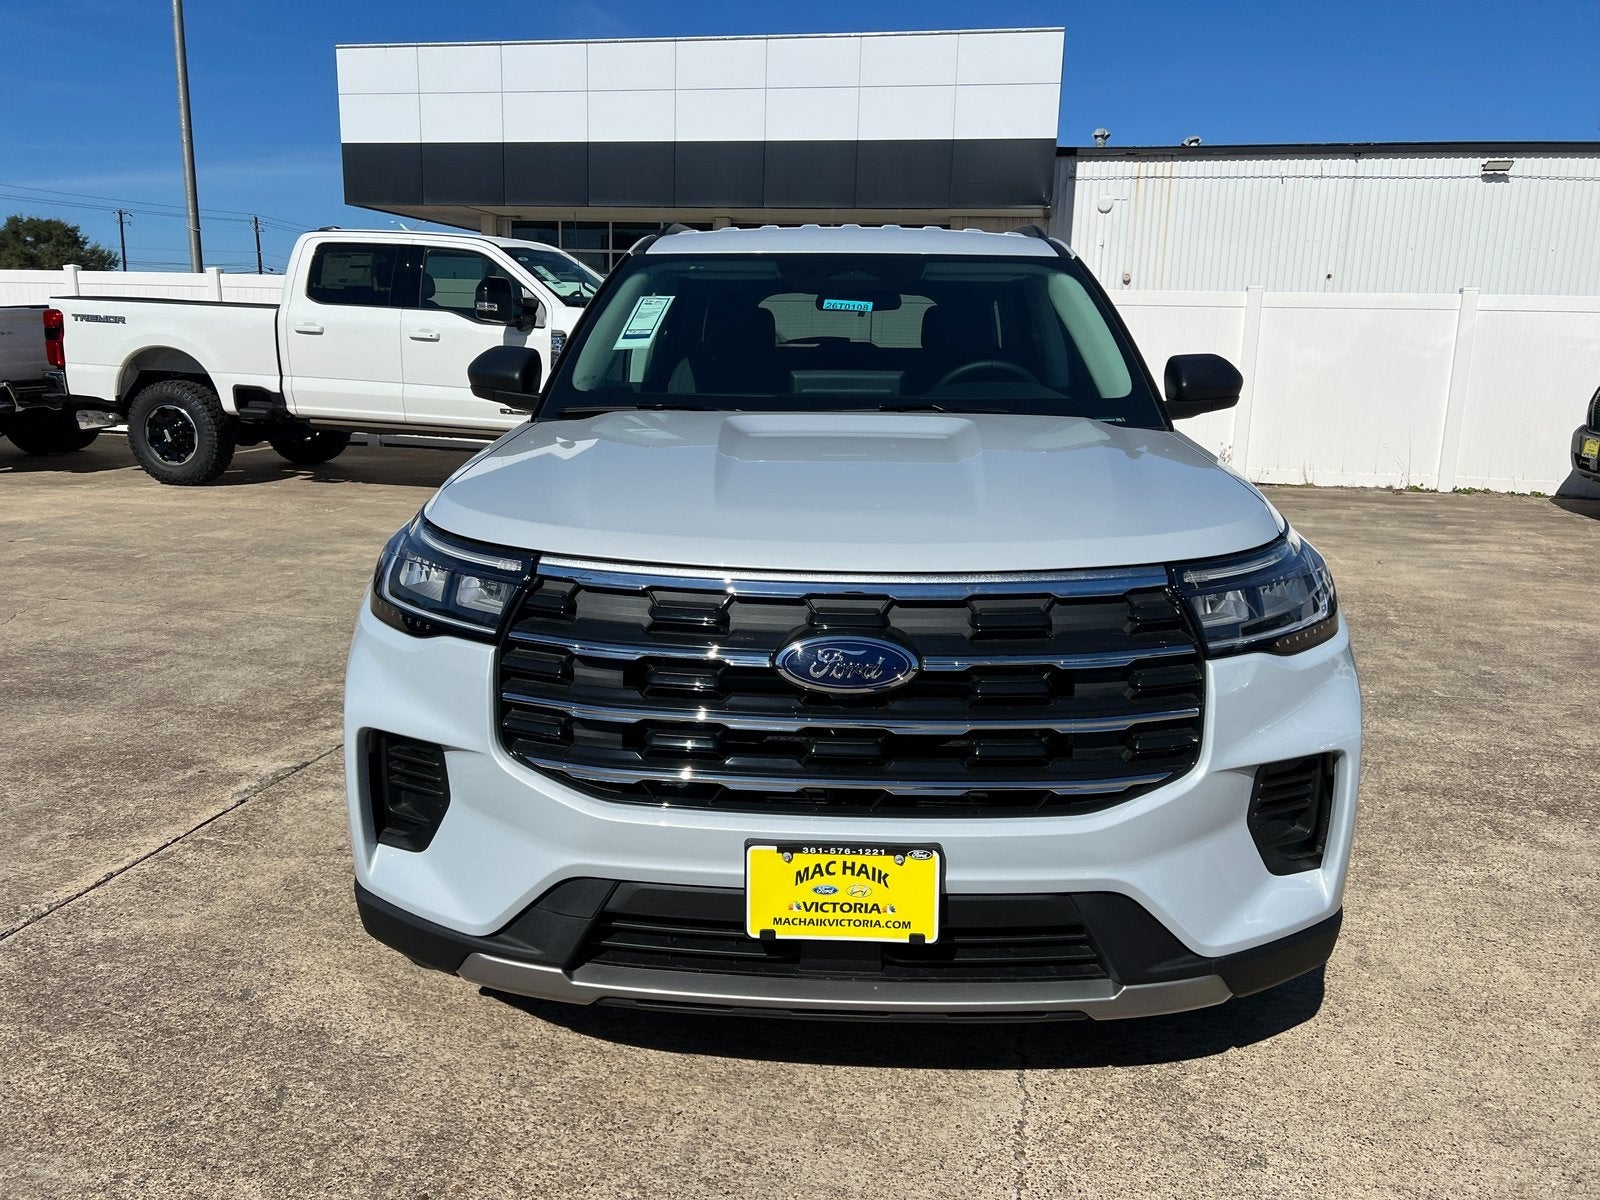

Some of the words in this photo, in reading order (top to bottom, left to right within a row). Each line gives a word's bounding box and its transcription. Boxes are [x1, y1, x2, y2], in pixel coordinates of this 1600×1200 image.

[825, 302, 870, 311] 26T0108
[71, 313, 126, 324] TREMOR
[808, 647, 886, 680] Ford
[802, 847, 885, 856] 361-576-1221
[795, 860, 837, 886] MAC
[842, 860, 890, 889] HAIK
[816, 885, 835, 895] Ford
[802, 901, 882, 914] VICTORIA
[772, 917, 912, 930] MACHAIKVICTORIA.COM
